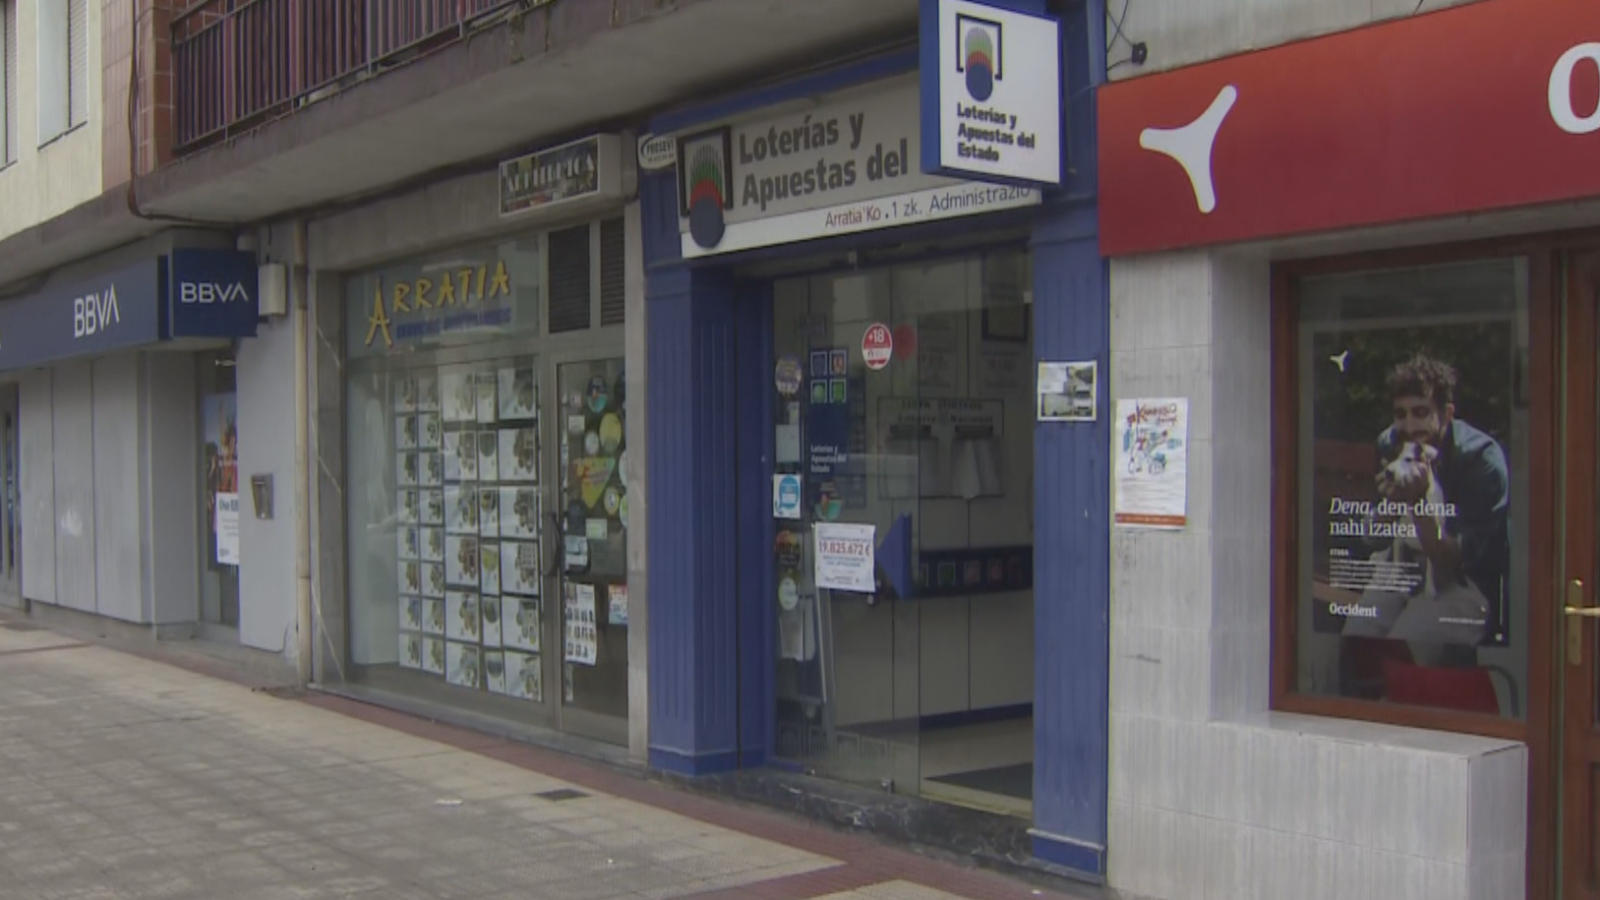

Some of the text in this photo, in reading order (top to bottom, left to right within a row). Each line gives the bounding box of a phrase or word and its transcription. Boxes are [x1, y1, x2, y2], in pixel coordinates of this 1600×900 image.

[957, 102, 1017, 130] Loterías y
[739, 112, 865, 165] Loterías y
[958, 122, 1035, 149] Apuestas del
[957, 142, 999, 162] Estado
[741, 138, 908, 211] Apuestas del
[181, 282, 249, 303] BBVA
[364, 259, 511, 347] ARRATIA
[74, 282, 120, 338] BBVA
[868, 327, 886, 344] +18
[1328, 497, 1456, 517] Dena, den-dena
[1329, 518, 1417, 538] nahi izatea
[1328, 602, 1377, 618] Occident
